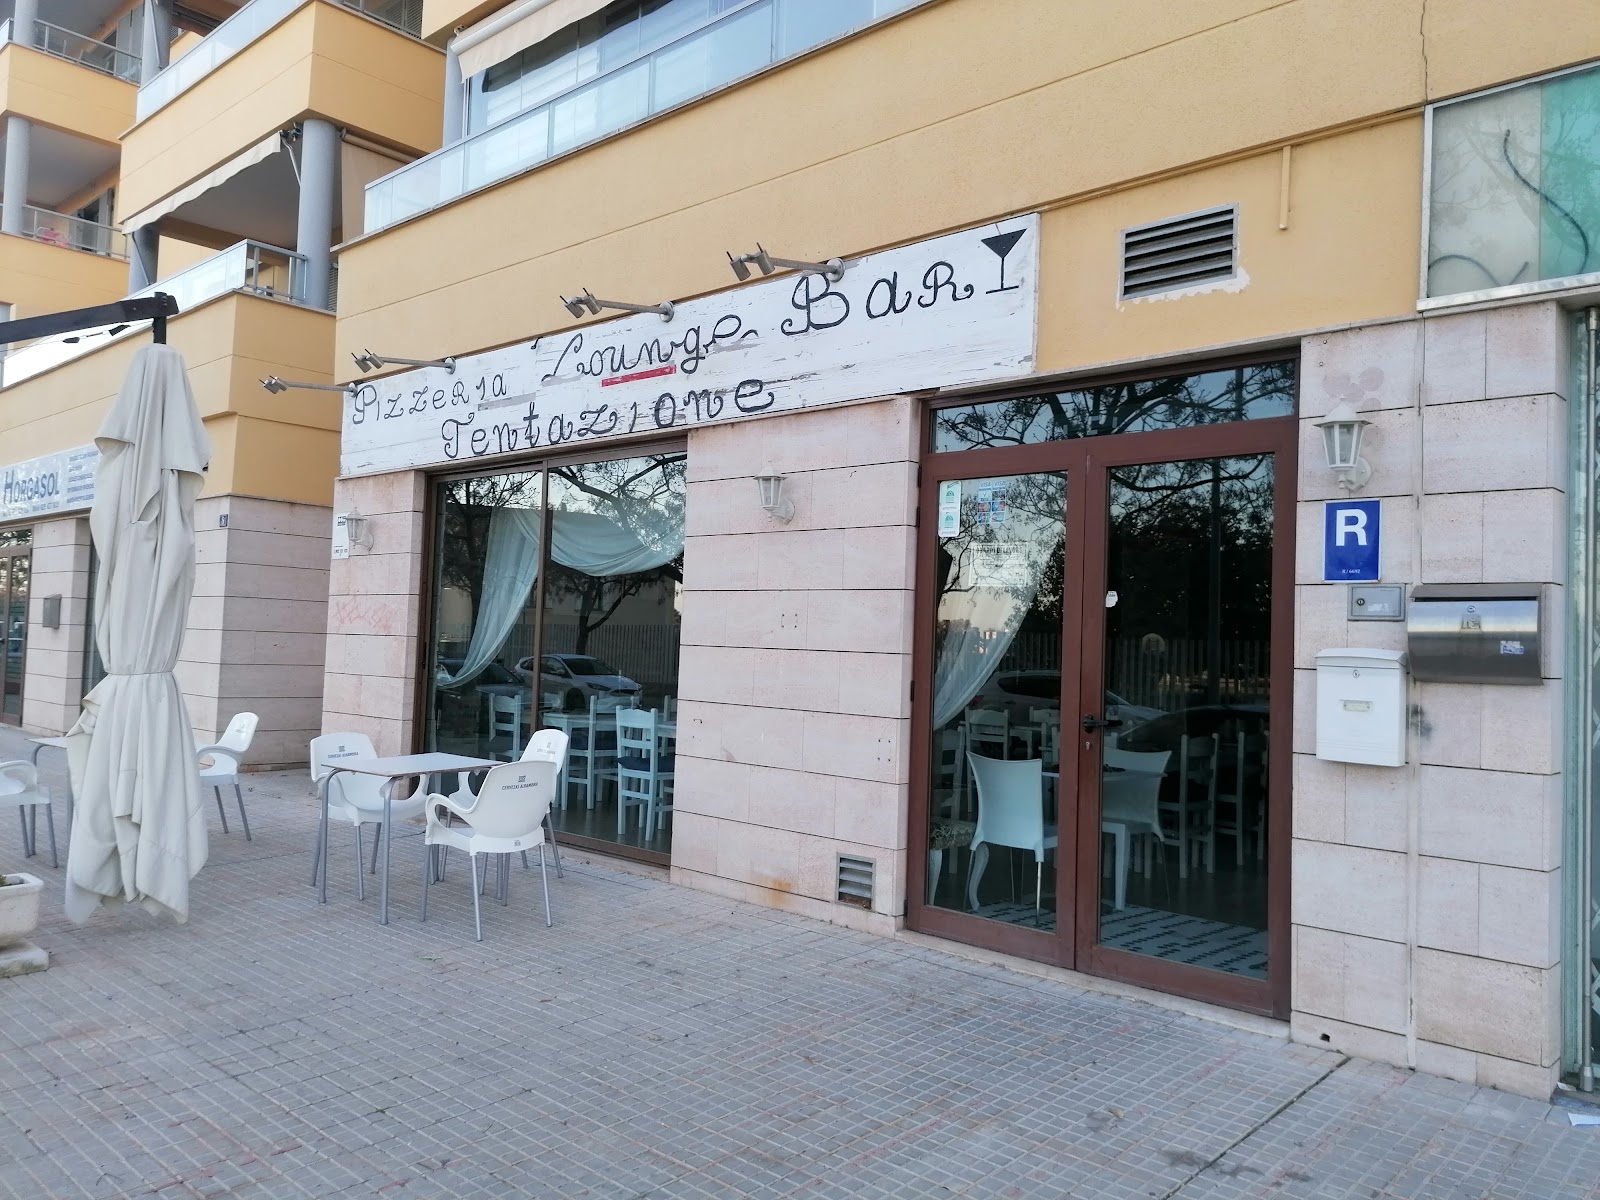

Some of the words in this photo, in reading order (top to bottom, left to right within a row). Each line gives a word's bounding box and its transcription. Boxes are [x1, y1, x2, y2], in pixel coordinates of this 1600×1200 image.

[541, 314, 759, 375] Lounge
[441, 379, 774, 458] Tentazione
[1335, 508, 1368, 547] R
